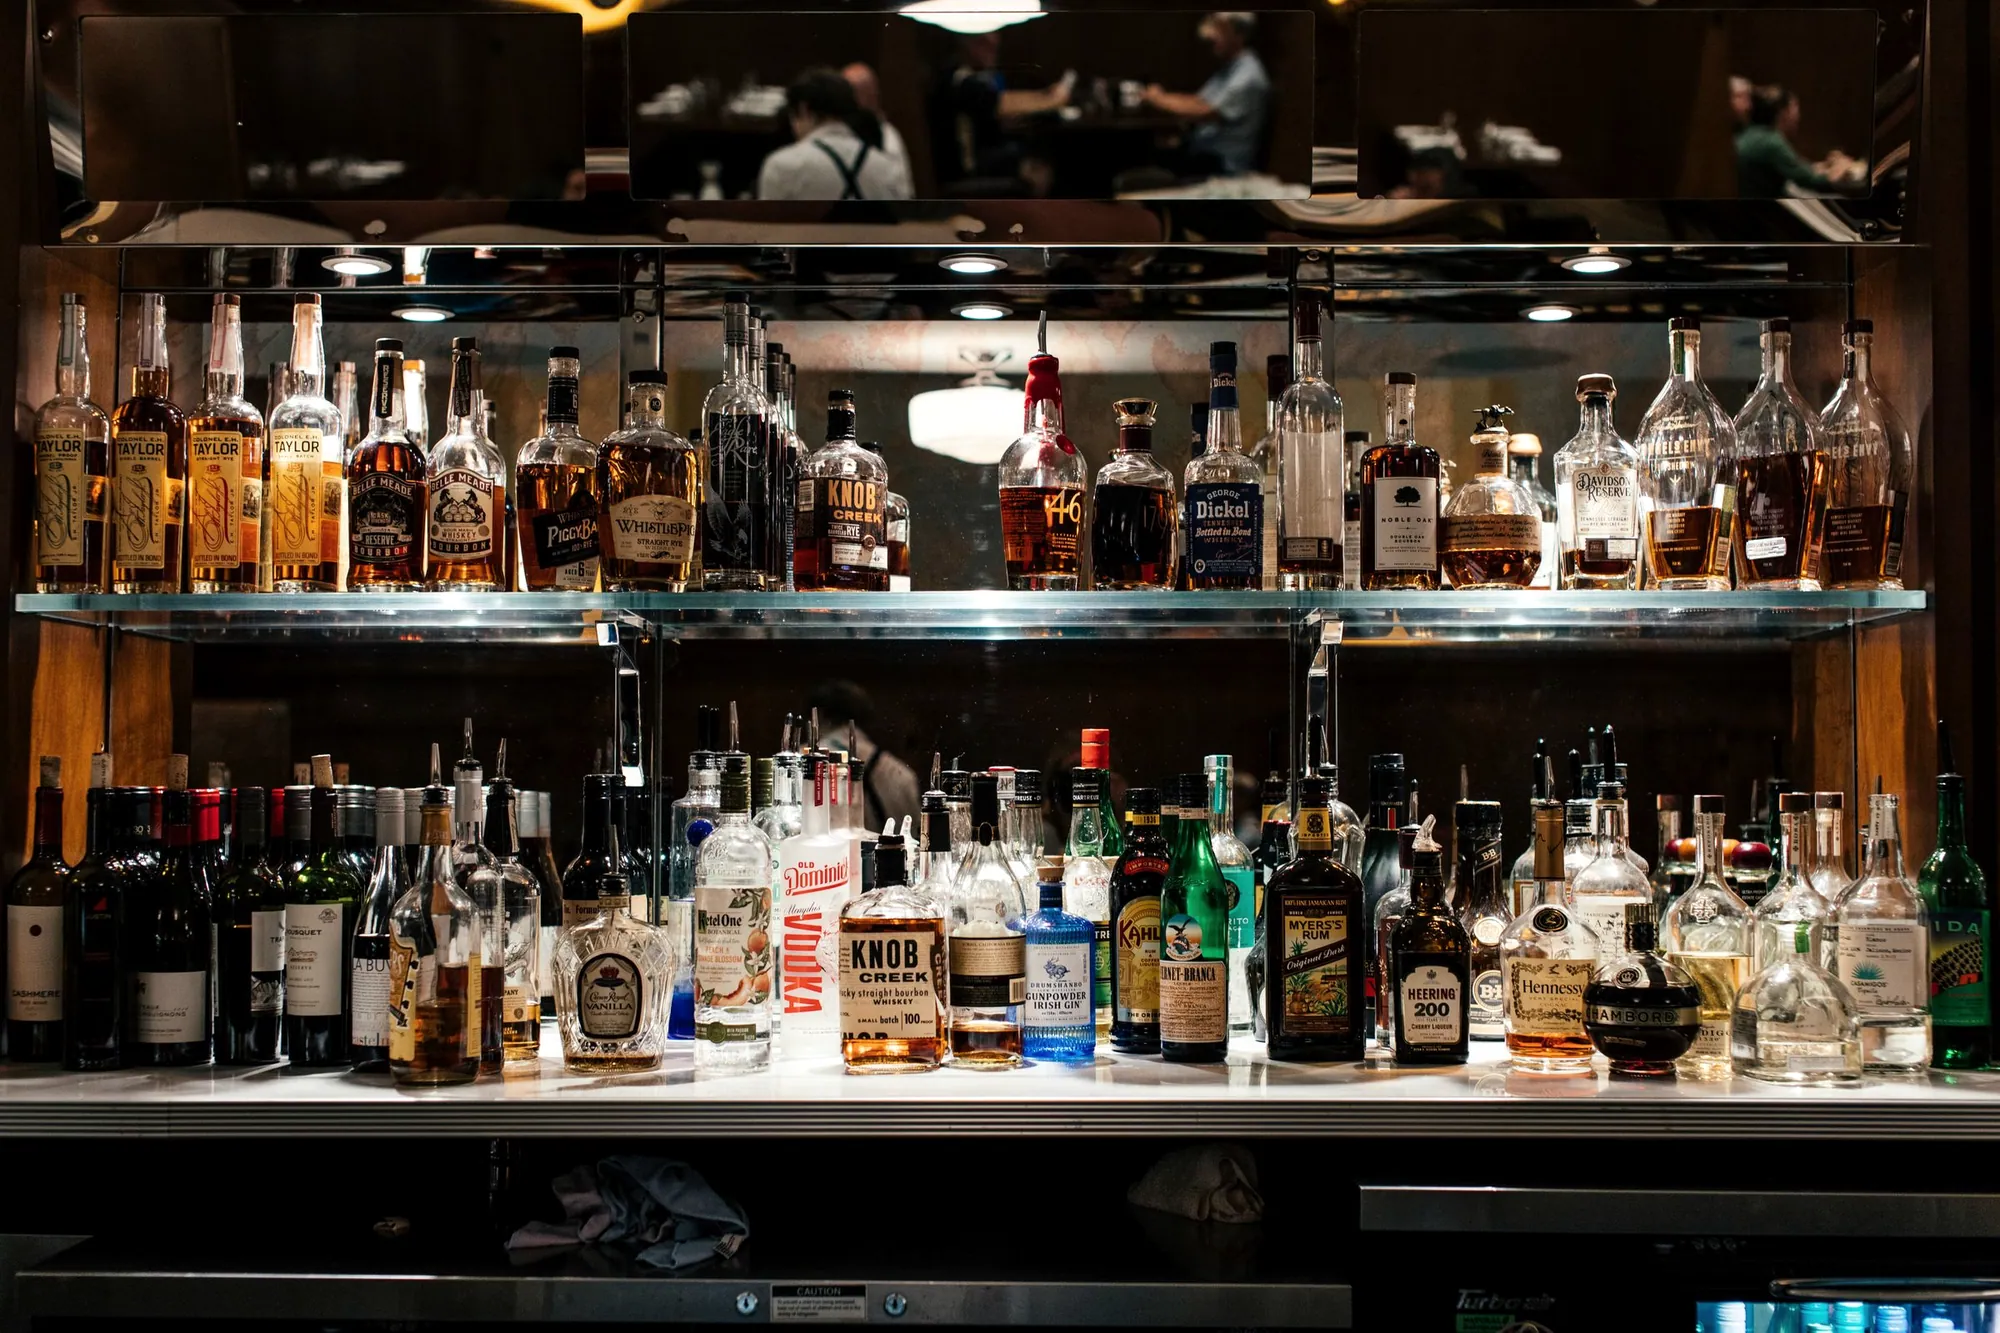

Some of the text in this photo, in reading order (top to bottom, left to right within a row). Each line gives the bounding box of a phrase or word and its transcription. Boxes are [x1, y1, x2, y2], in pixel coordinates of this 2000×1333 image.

[118, 443, 164, 456] TAYLOR
[193, 443, 239, 456] TAYLOR
[274, 441, 319, 453] TAYLOR
[352, 477, 412, 496] BELLE MEADE
[431, 472, 492, 492] BELLE MEADE
[1576, 472, 1631, 491] DAVIDSON
[828, 480, 877, 510] KNOB
[1206, 489, 1241, 500] GEORGE
[1588, 486, 1631, 503] RESERVE
[1047, 488, 1082, 524] 46
[1196, 501, 1250, 519] Dickel
[833, 511, 882, 523] CREEK
[547, 518, 598, 548] PIGGYBA
[615, 518, 696, 537] WHISTLEPIG
[846, 526, 861, 537] RYE
[1195, 527, 1252, 537] Bottled in Bond
[365, 534, 395, 546] RESERVE
[432, 541, 487, 551] BOURBON
[354, 545, 408, 556] BOURBON
[578, 561, 585, 577] 6
[721, 913, 743, 926] One
[1289, 920, 1342, 930] MYERS'S
[1119, 919, 1160, 949] KAHL
[1934, 920, 1980, 936] IDA
[1302, 930, 1330, 940] RUM
[714, 955, 743, 963] BLOSSOM
[852, 939, 919, 969] KNOB
[1286, 943, 1345, 971] Original Dark
[784, 912, 823, 1014] VODKA
[859, 972, 929, 983] CREEK
[1160, 966, 1216, 982] ERNET-BRANCA
[1030, 981, 1083, 989] DRUMSHANBO
[1522, 979, 1585, 997] Hennessy
[12, 989, 61, 998] CASHMERE
[503, 988, 518, 996] PANY
[858, 988, 893, 1000] straight
[895, 987, 929, 997] bourbon
[1025, 991, 1087, 1001] GUNPOWDER
[1408, 988, 1456, 1001] HEERING
[1034, 1000, 1080, 1009] IRISH GIN
[1414, 1002, 1450, 1017] 200
[879, 1015, 899, 1024] batch
[904, 1013, 921, 1025] 100
[796, 1286, 841, 1297] CAUTION
[1456, 1287, 1521, 1311] Turbo
